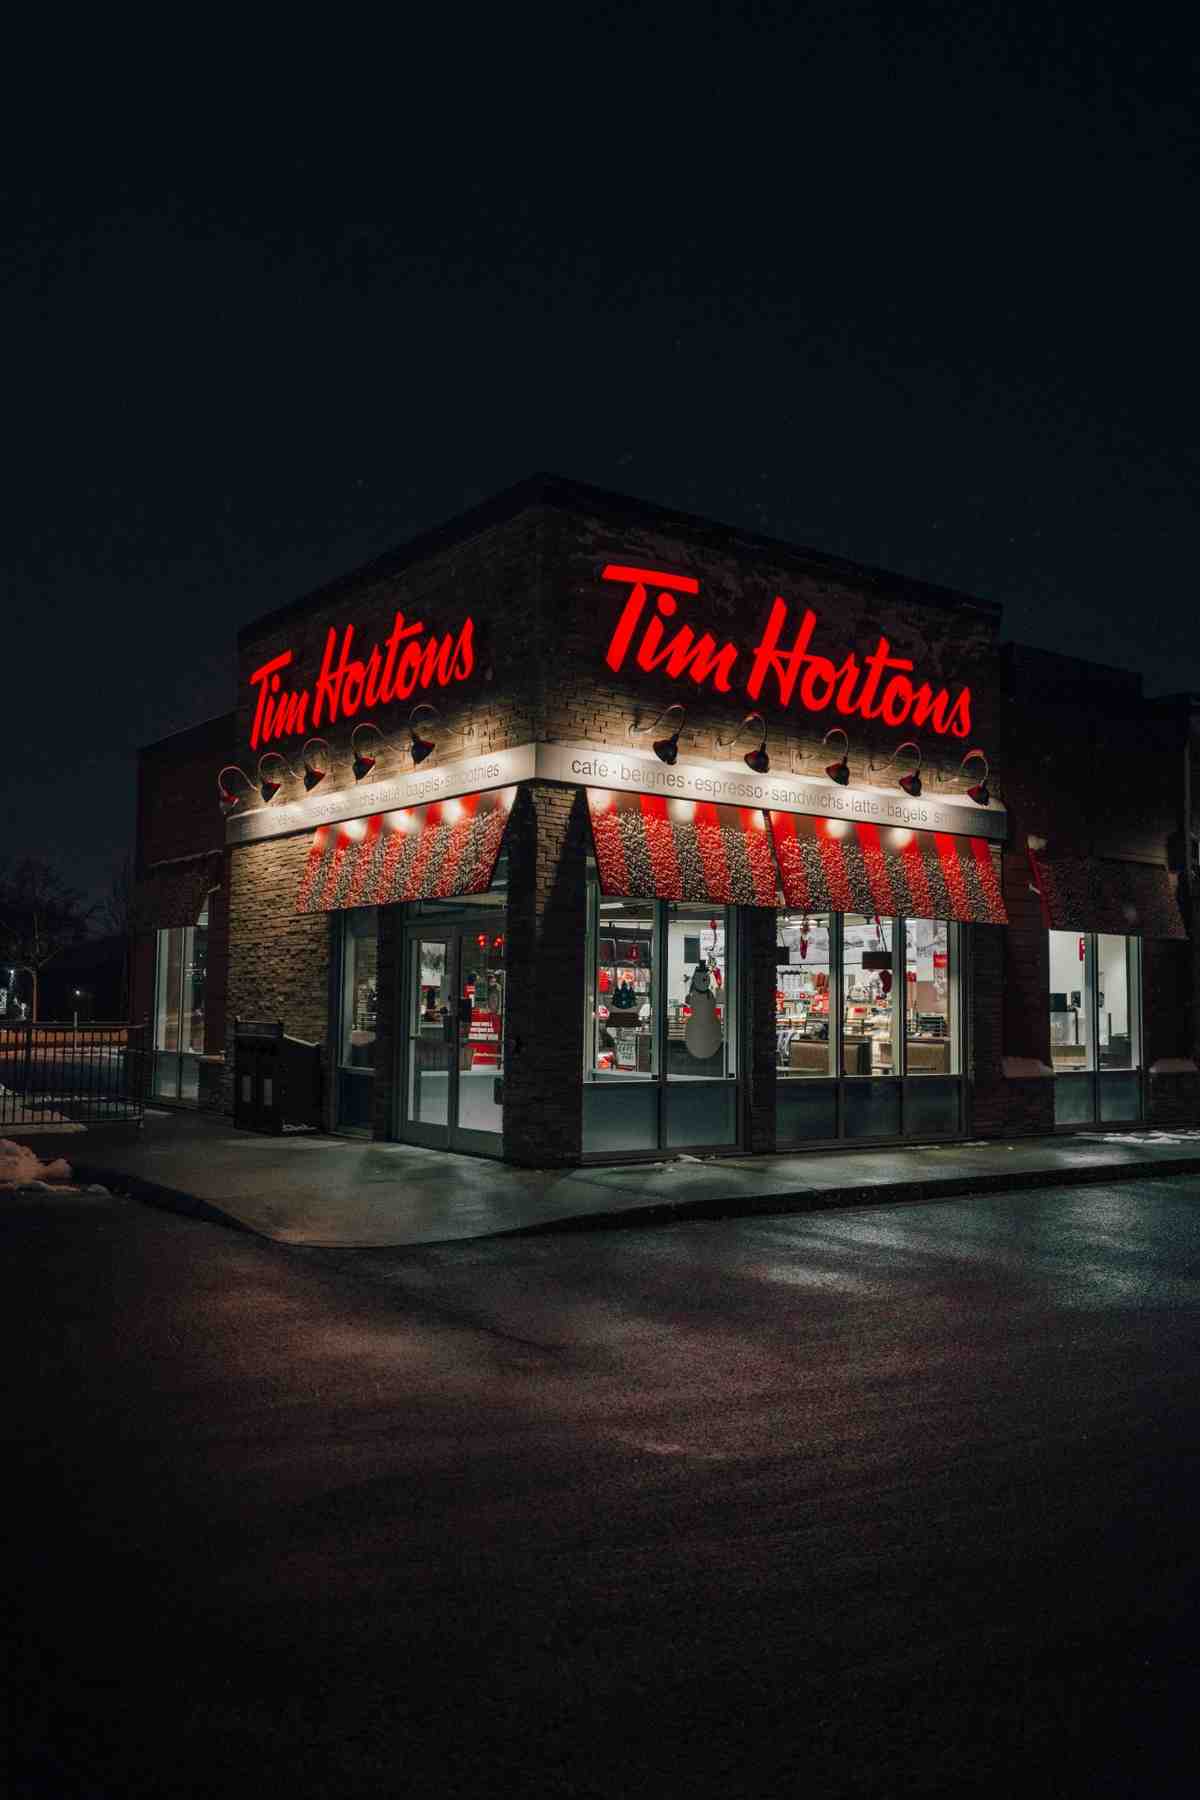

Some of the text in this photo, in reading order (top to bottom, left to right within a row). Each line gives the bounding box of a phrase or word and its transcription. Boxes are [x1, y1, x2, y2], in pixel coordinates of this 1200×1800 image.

[249, 611, 475, 750] Tim Hortons
[602, 565, 973, 738] Tim Hortons
[620, 761, 685, 787] beignes
[694, 777, 762, 799] espresso
[851, 800, 880, 816] latte
[887, 806, 928, 823] bagels
